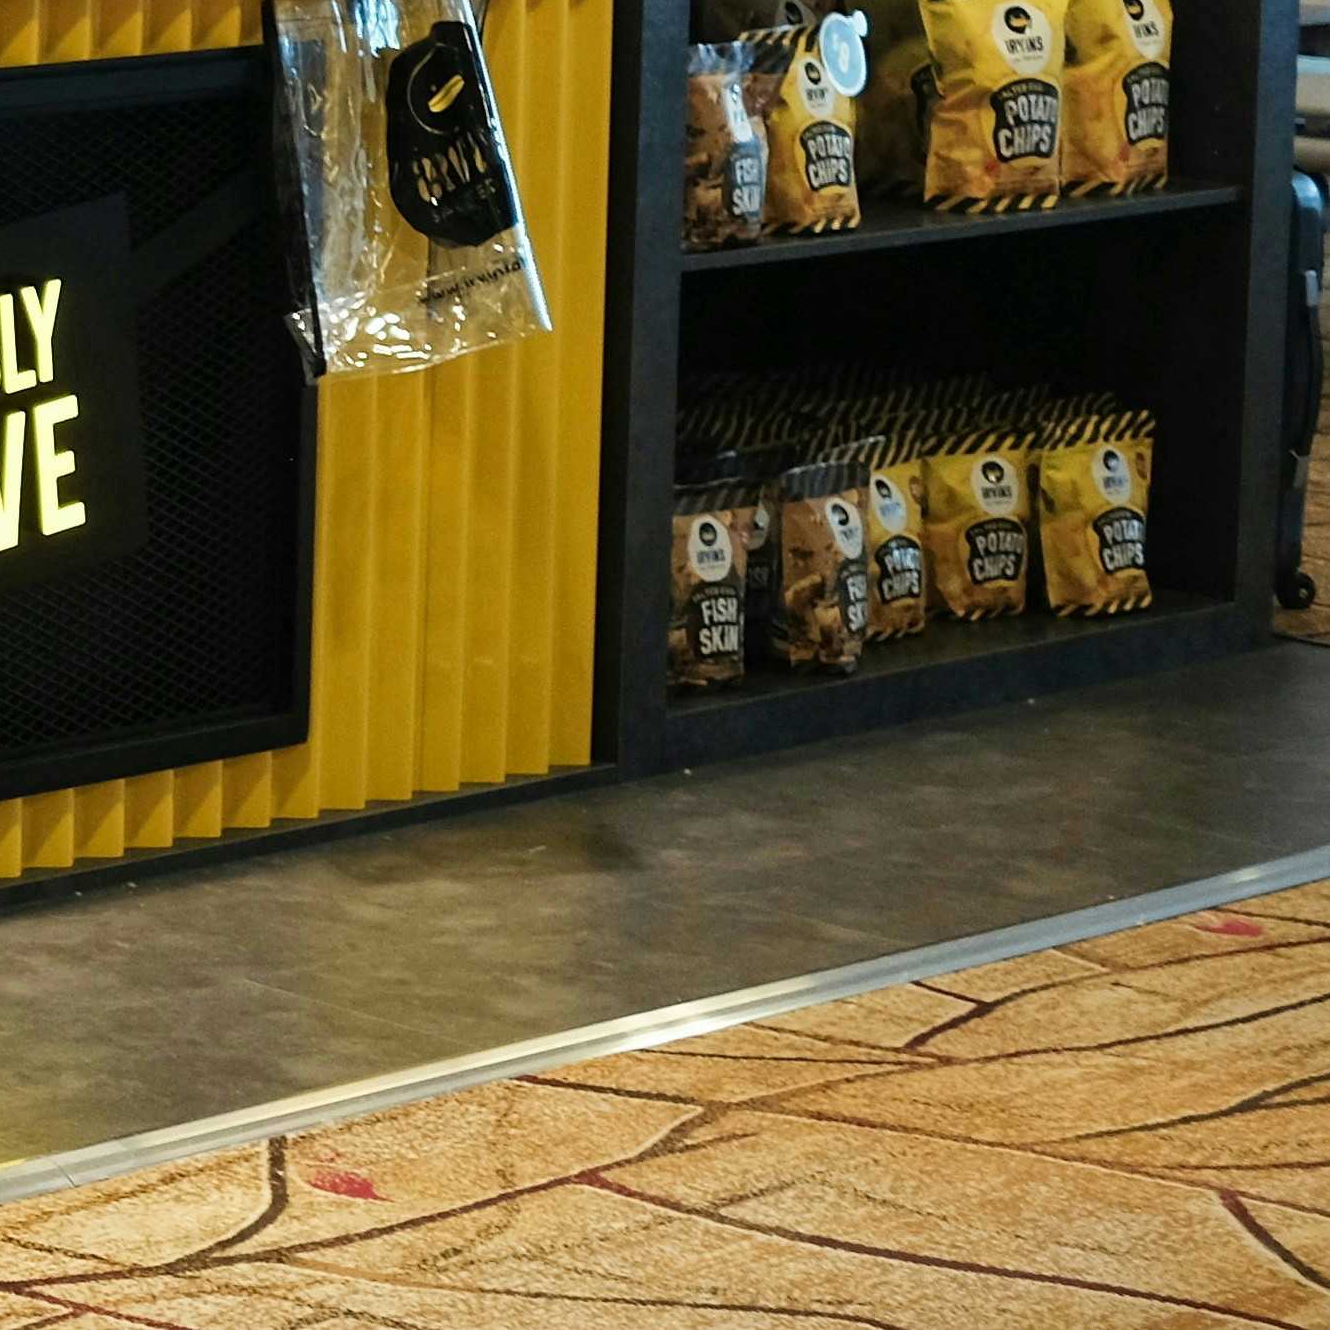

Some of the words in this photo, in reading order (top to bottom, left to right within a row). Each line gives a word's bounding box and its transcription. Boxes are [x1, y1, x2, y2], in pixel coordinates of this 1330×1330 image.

[1127, 107, 1166, 139] CHIPS
[996, 125, 1052, 158] CHIPS
[808, 157, 848, 189] CHIPS
[972, 553, 1017, 582] CHIPS
[1101, 543, 1145, 571] CHIPS
[701, 596, 738, 626] FISH
[699, 624, 739, 655] SKIN
